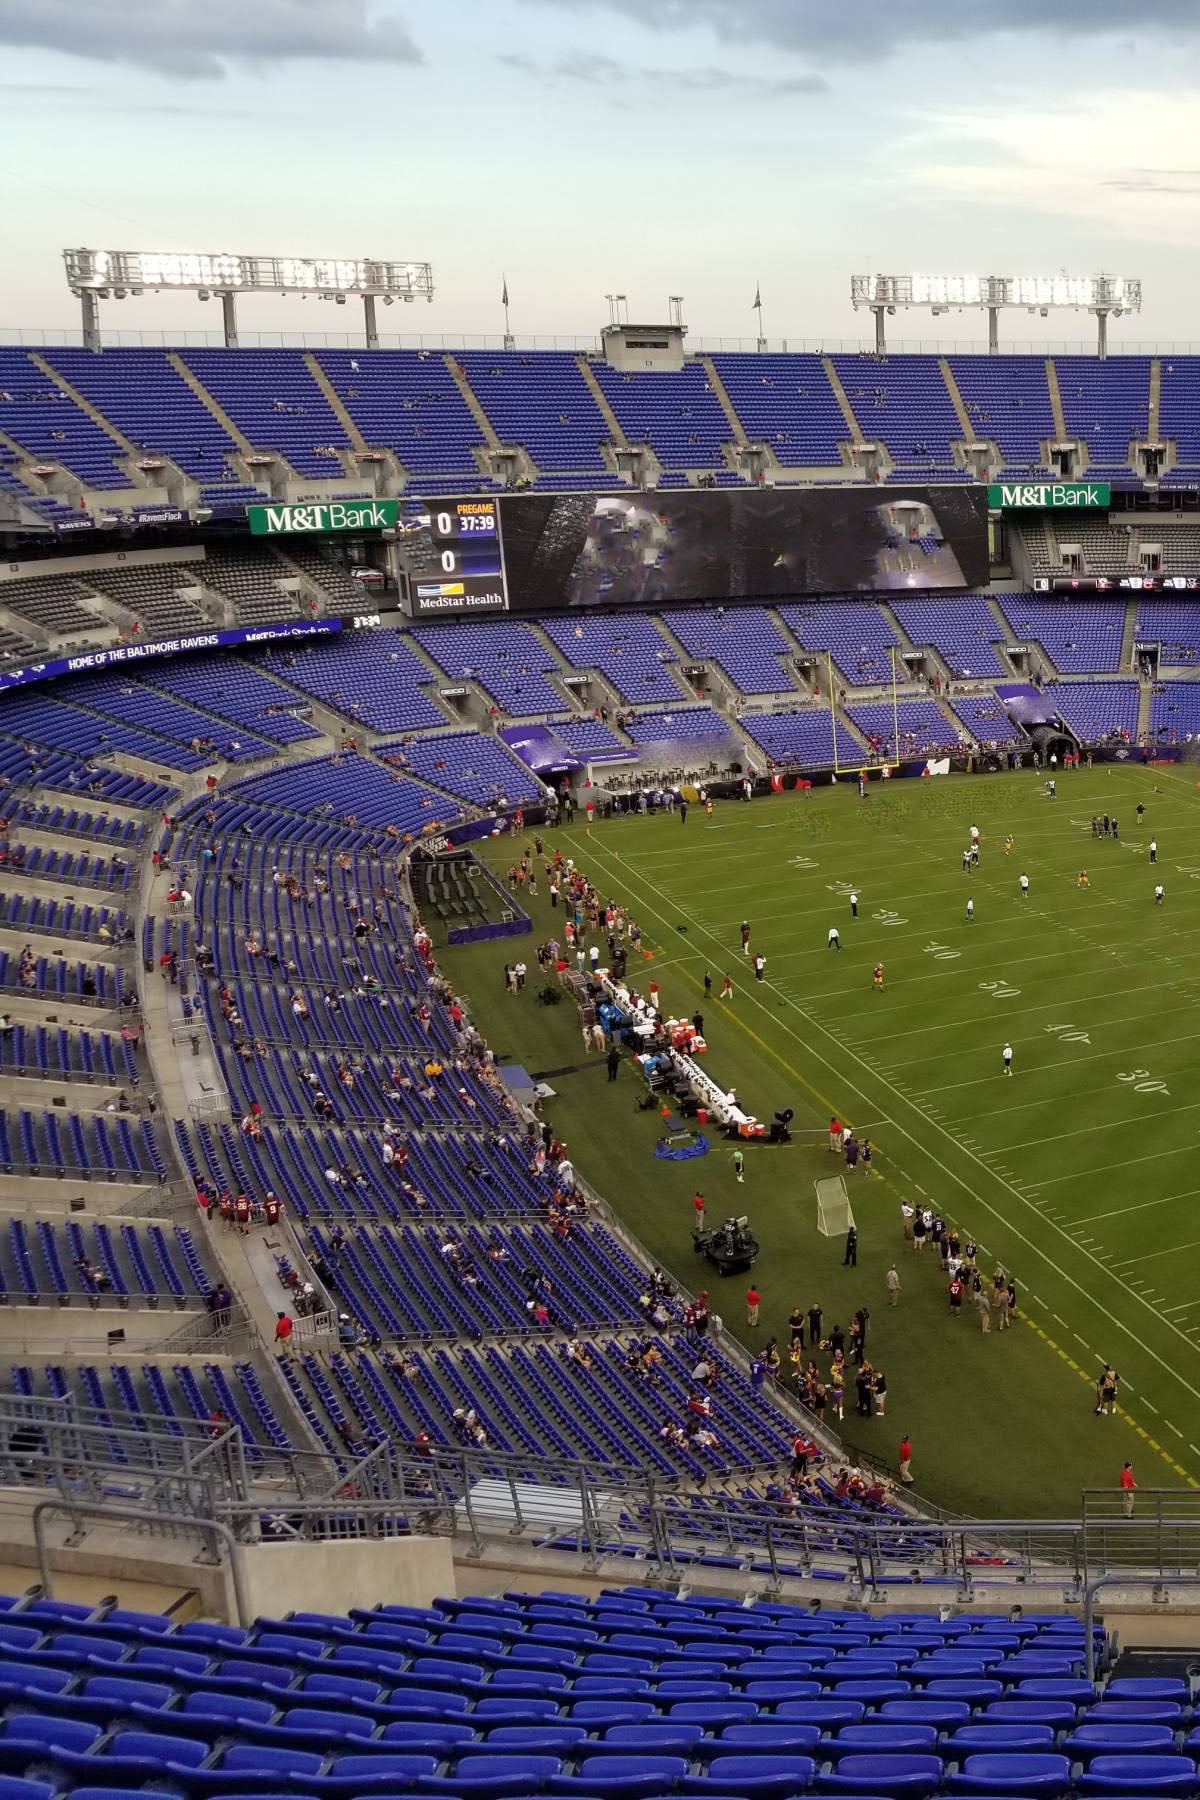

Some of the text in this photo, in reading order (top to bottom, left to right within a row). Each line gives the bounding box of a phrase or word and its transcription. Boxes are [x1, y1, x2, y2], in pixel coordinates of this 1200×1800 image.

[1000, 485, 1099, 506] M&T Bank
[265, 503, 388, 533] M&T Bank
[457, 503, 495, 515] PREGAME
[437, 512, 452, 534] 0
[460, 515, 495, 531] 37:39
[441, 550, 456, 572] 0
[420, 593, 503, 609] MedStar Health
[68, 634, 219, 670] HOME OF THE BALTIMORE RAVENS
[873, 908, 910, 927] 30
[923, 941, 963, 960] 40
[978, 979, 1023, 998] 50
[1043, 1022, 1090, 1043] 40
[1115, 1069, 1168, 1094] 30
[269, 1205, 277, 1214] 9
